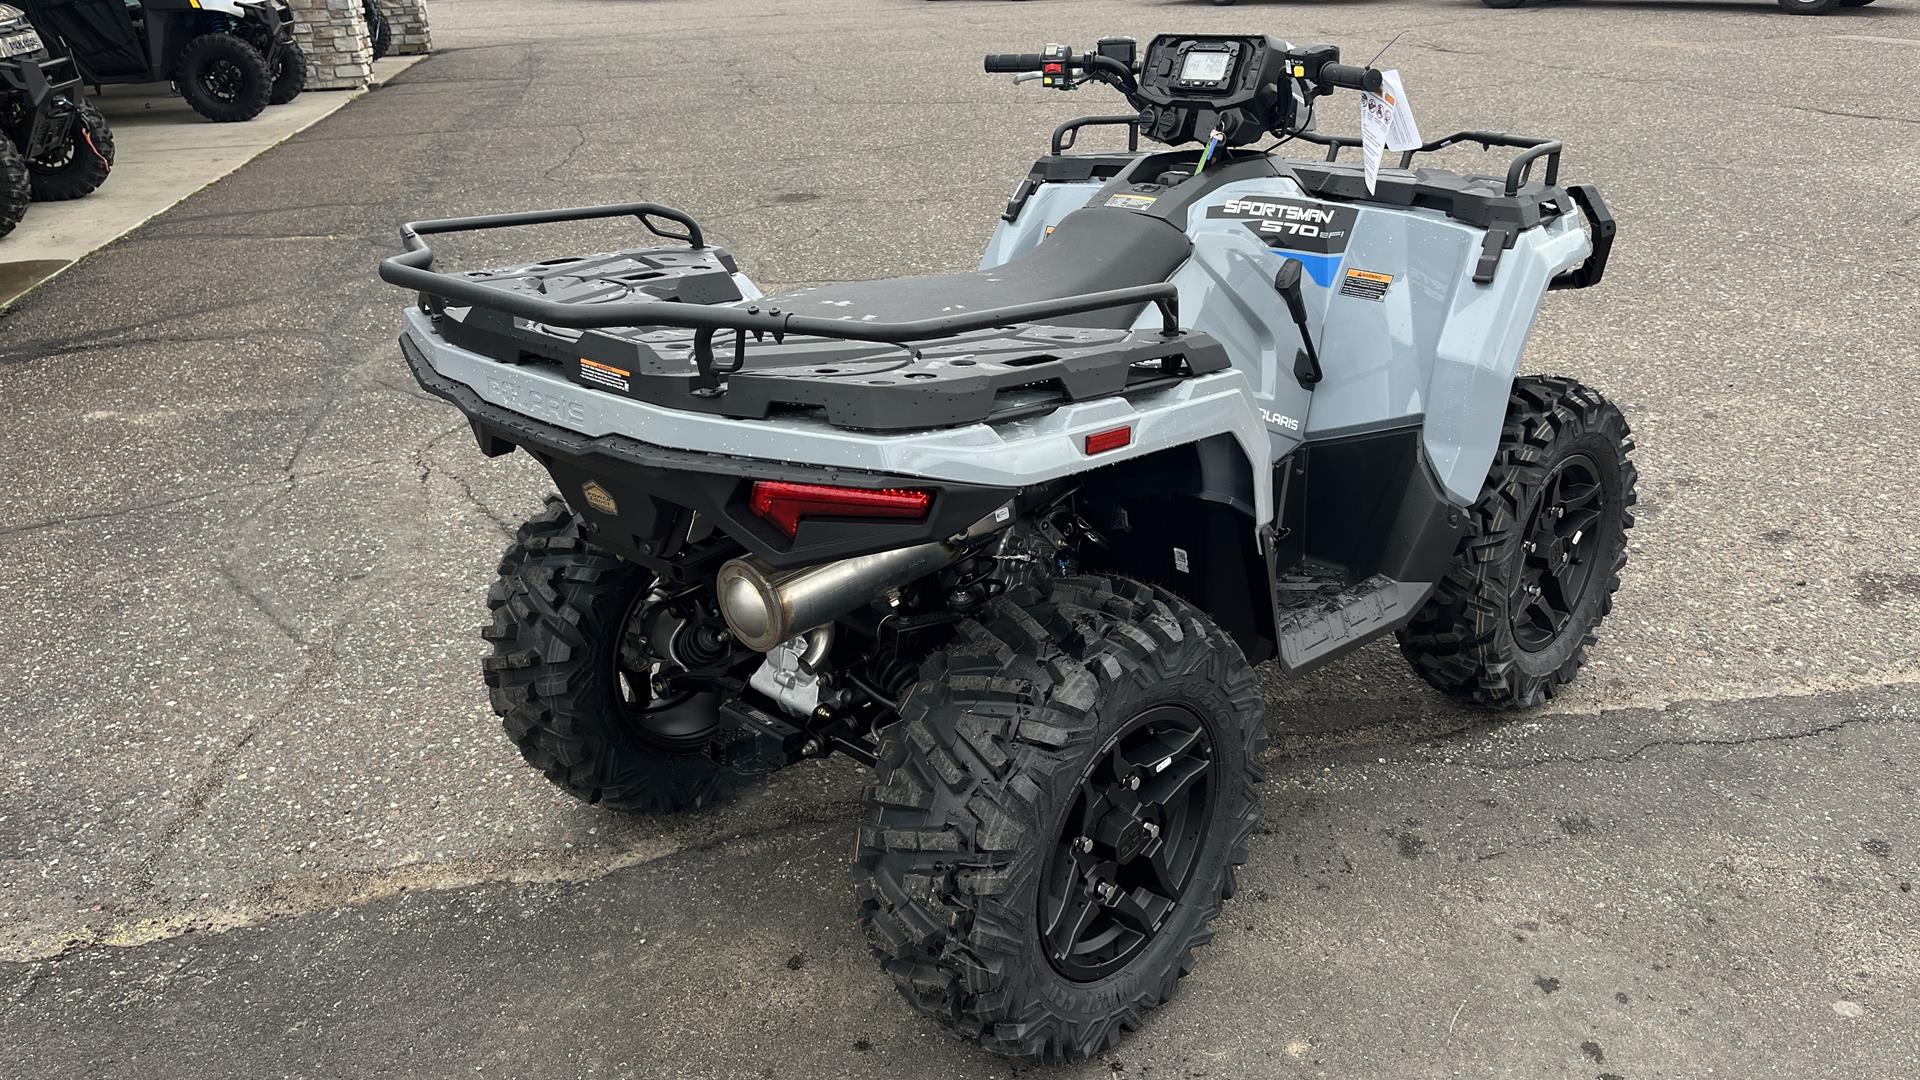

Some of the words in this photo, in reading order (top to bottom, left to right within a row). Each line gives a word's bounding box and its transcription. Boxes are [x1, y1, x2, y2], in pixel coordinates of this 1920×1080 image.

[1223, 199, 1335, 224] SPORTSMAN
[1259, 220, 1319, 238] 570
[486, 376, 586, 427] POLARIS
[588, 491, 611, 502] POWER
